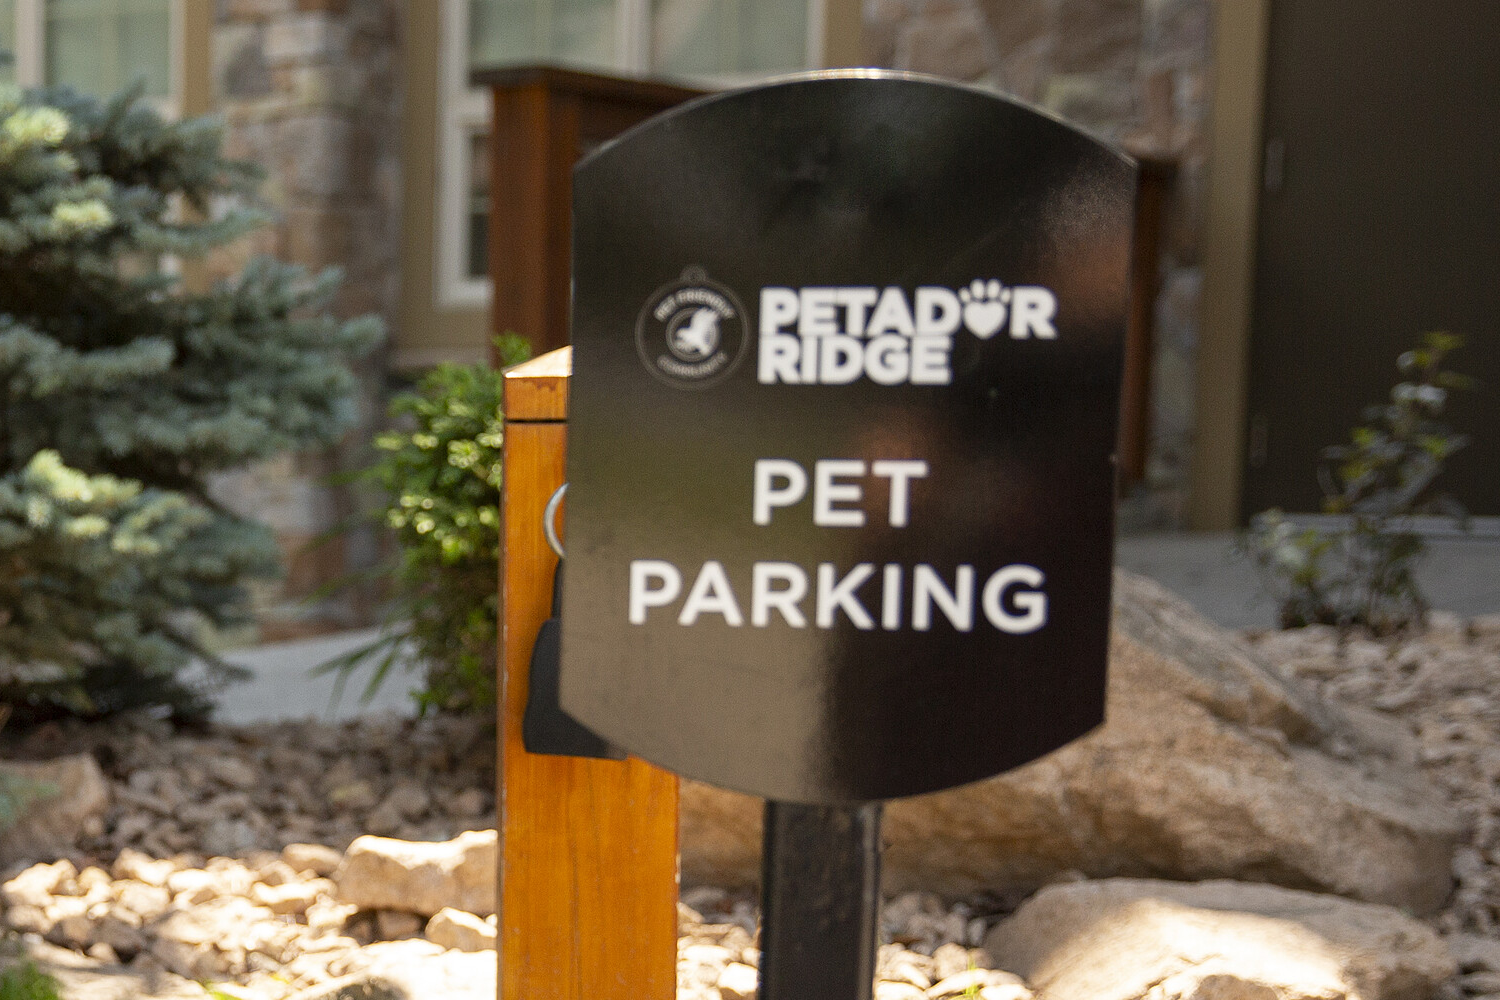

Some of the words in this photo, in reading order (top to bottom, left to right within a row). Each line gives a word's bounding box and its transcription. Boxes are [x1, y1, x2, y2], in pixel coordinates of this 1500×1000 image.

[758, 336, 952, 384] RIDGE
[753, 459, 928, 528] PET
[629, 560, 1049, 634] PARKING
